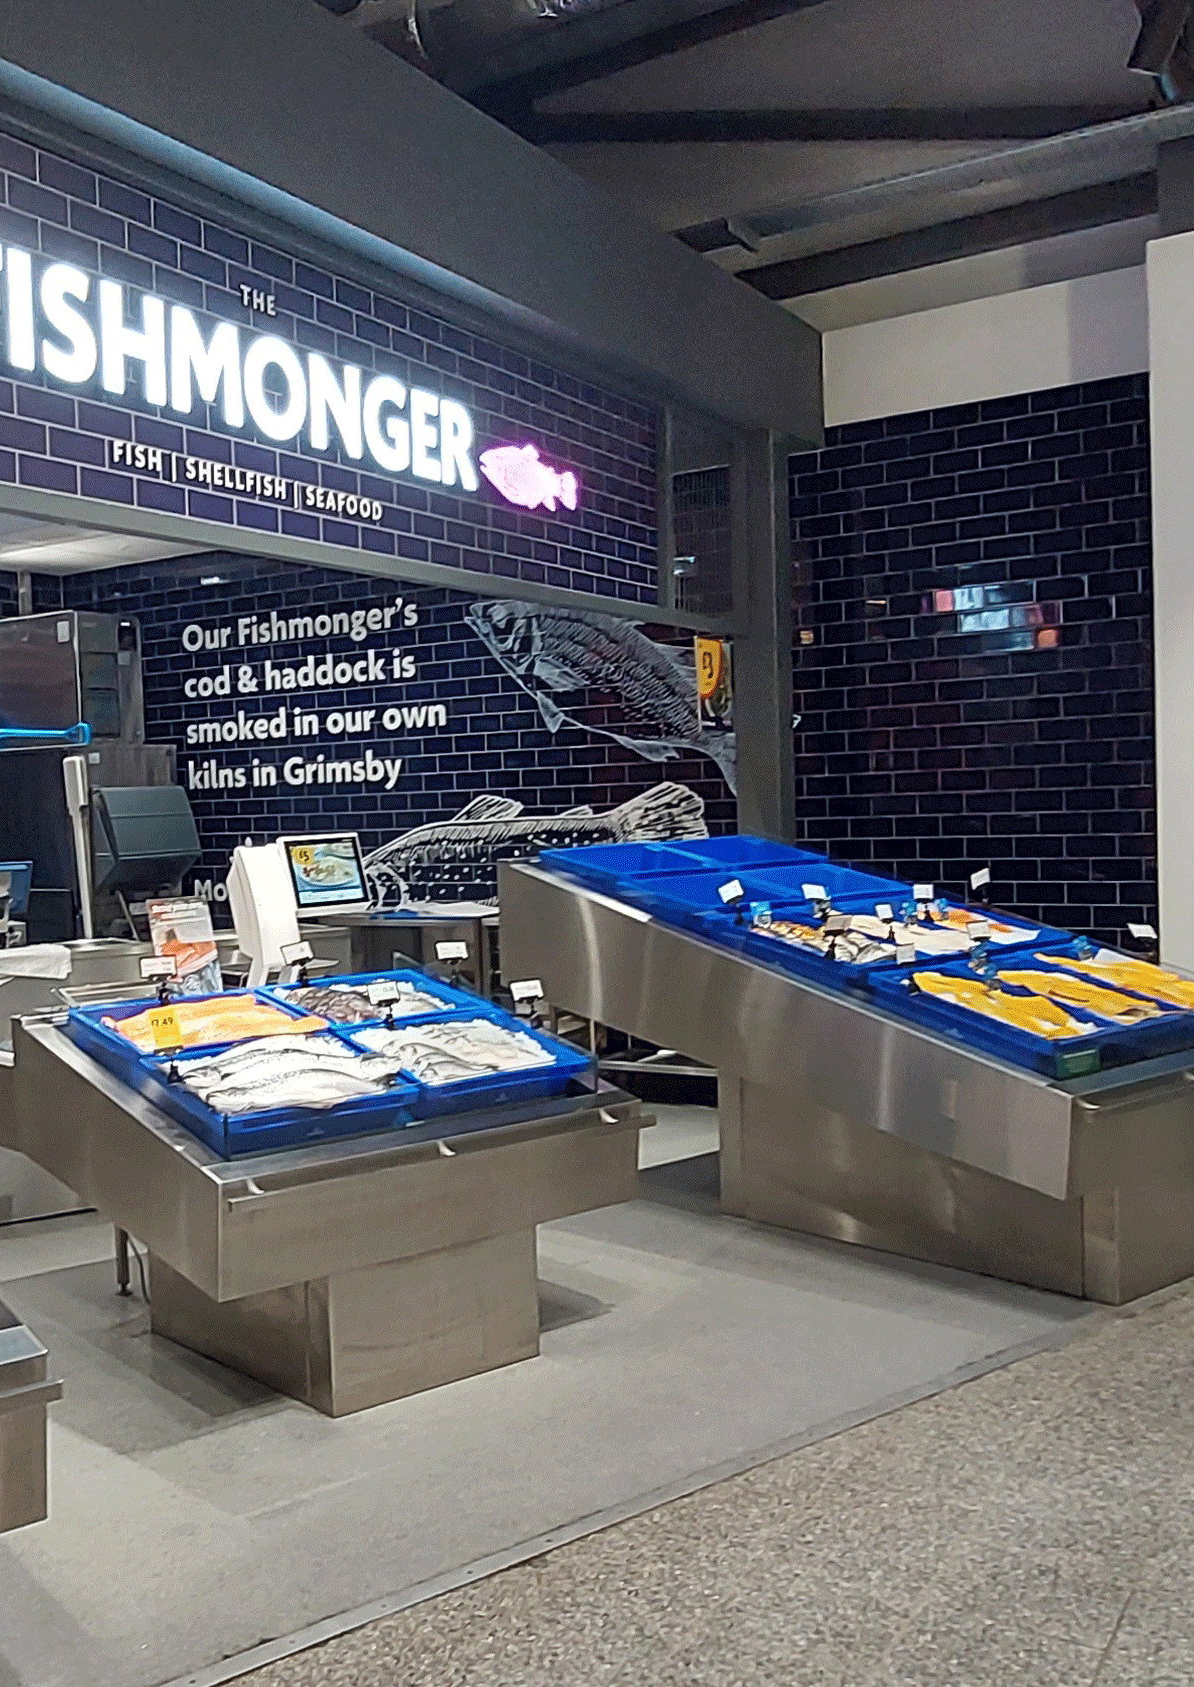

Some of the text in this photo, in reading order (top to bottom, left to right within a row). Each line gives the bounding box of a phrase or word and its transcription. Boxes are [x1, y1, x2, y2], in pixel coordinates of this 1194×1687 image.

[239, 283, 277, 316] THE
[112, 440, 383, 521] FISH SHELLFISH SEAFOOD
[182, 624, 231, 652] Our
[184, 648, 417, 698] cod & haddock is
[186, 704, 448, 744] smoked in our own
[187, 749, 403, 790] kilns in Grimsby
[194, 879, 228, 902] Mo
